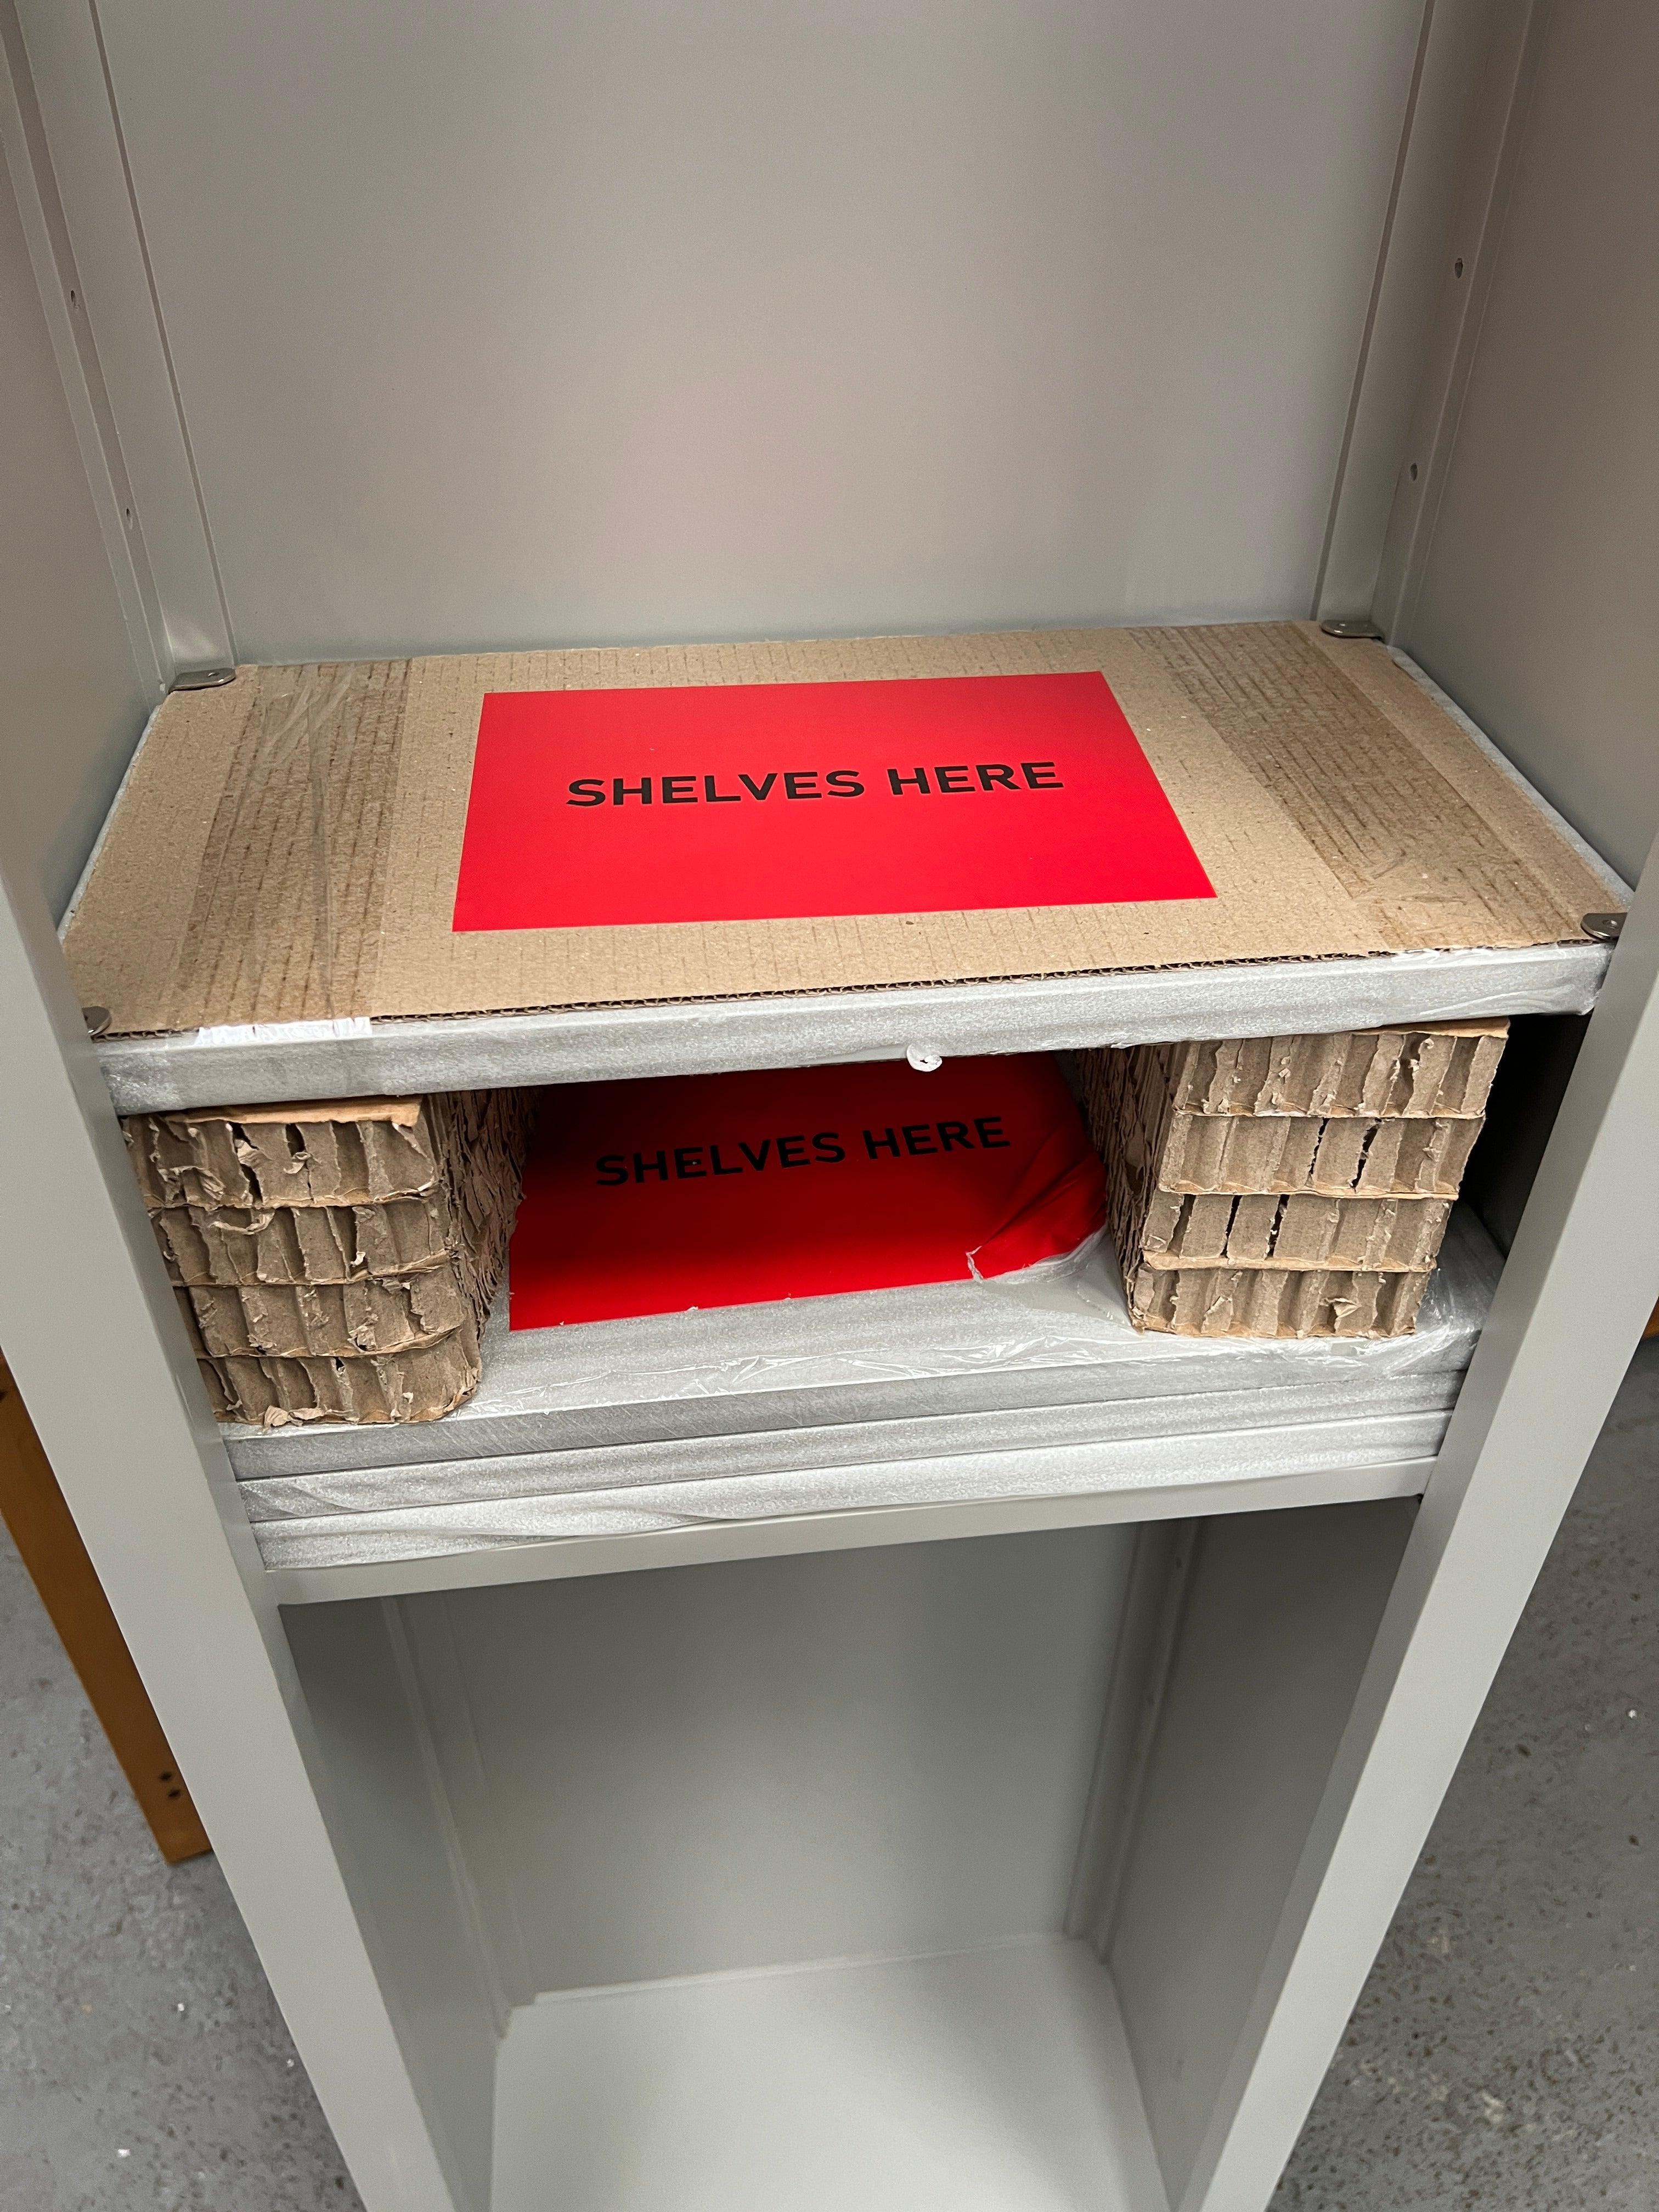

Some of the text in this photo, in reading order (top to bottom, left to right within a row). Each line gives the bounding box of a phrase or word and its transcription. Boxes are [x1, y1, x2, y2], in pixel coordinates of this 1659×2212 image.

[567, 761, 1063, 806] SHELVES HERE
[596, 1117, 1010, 1186] SHELVES HERE
